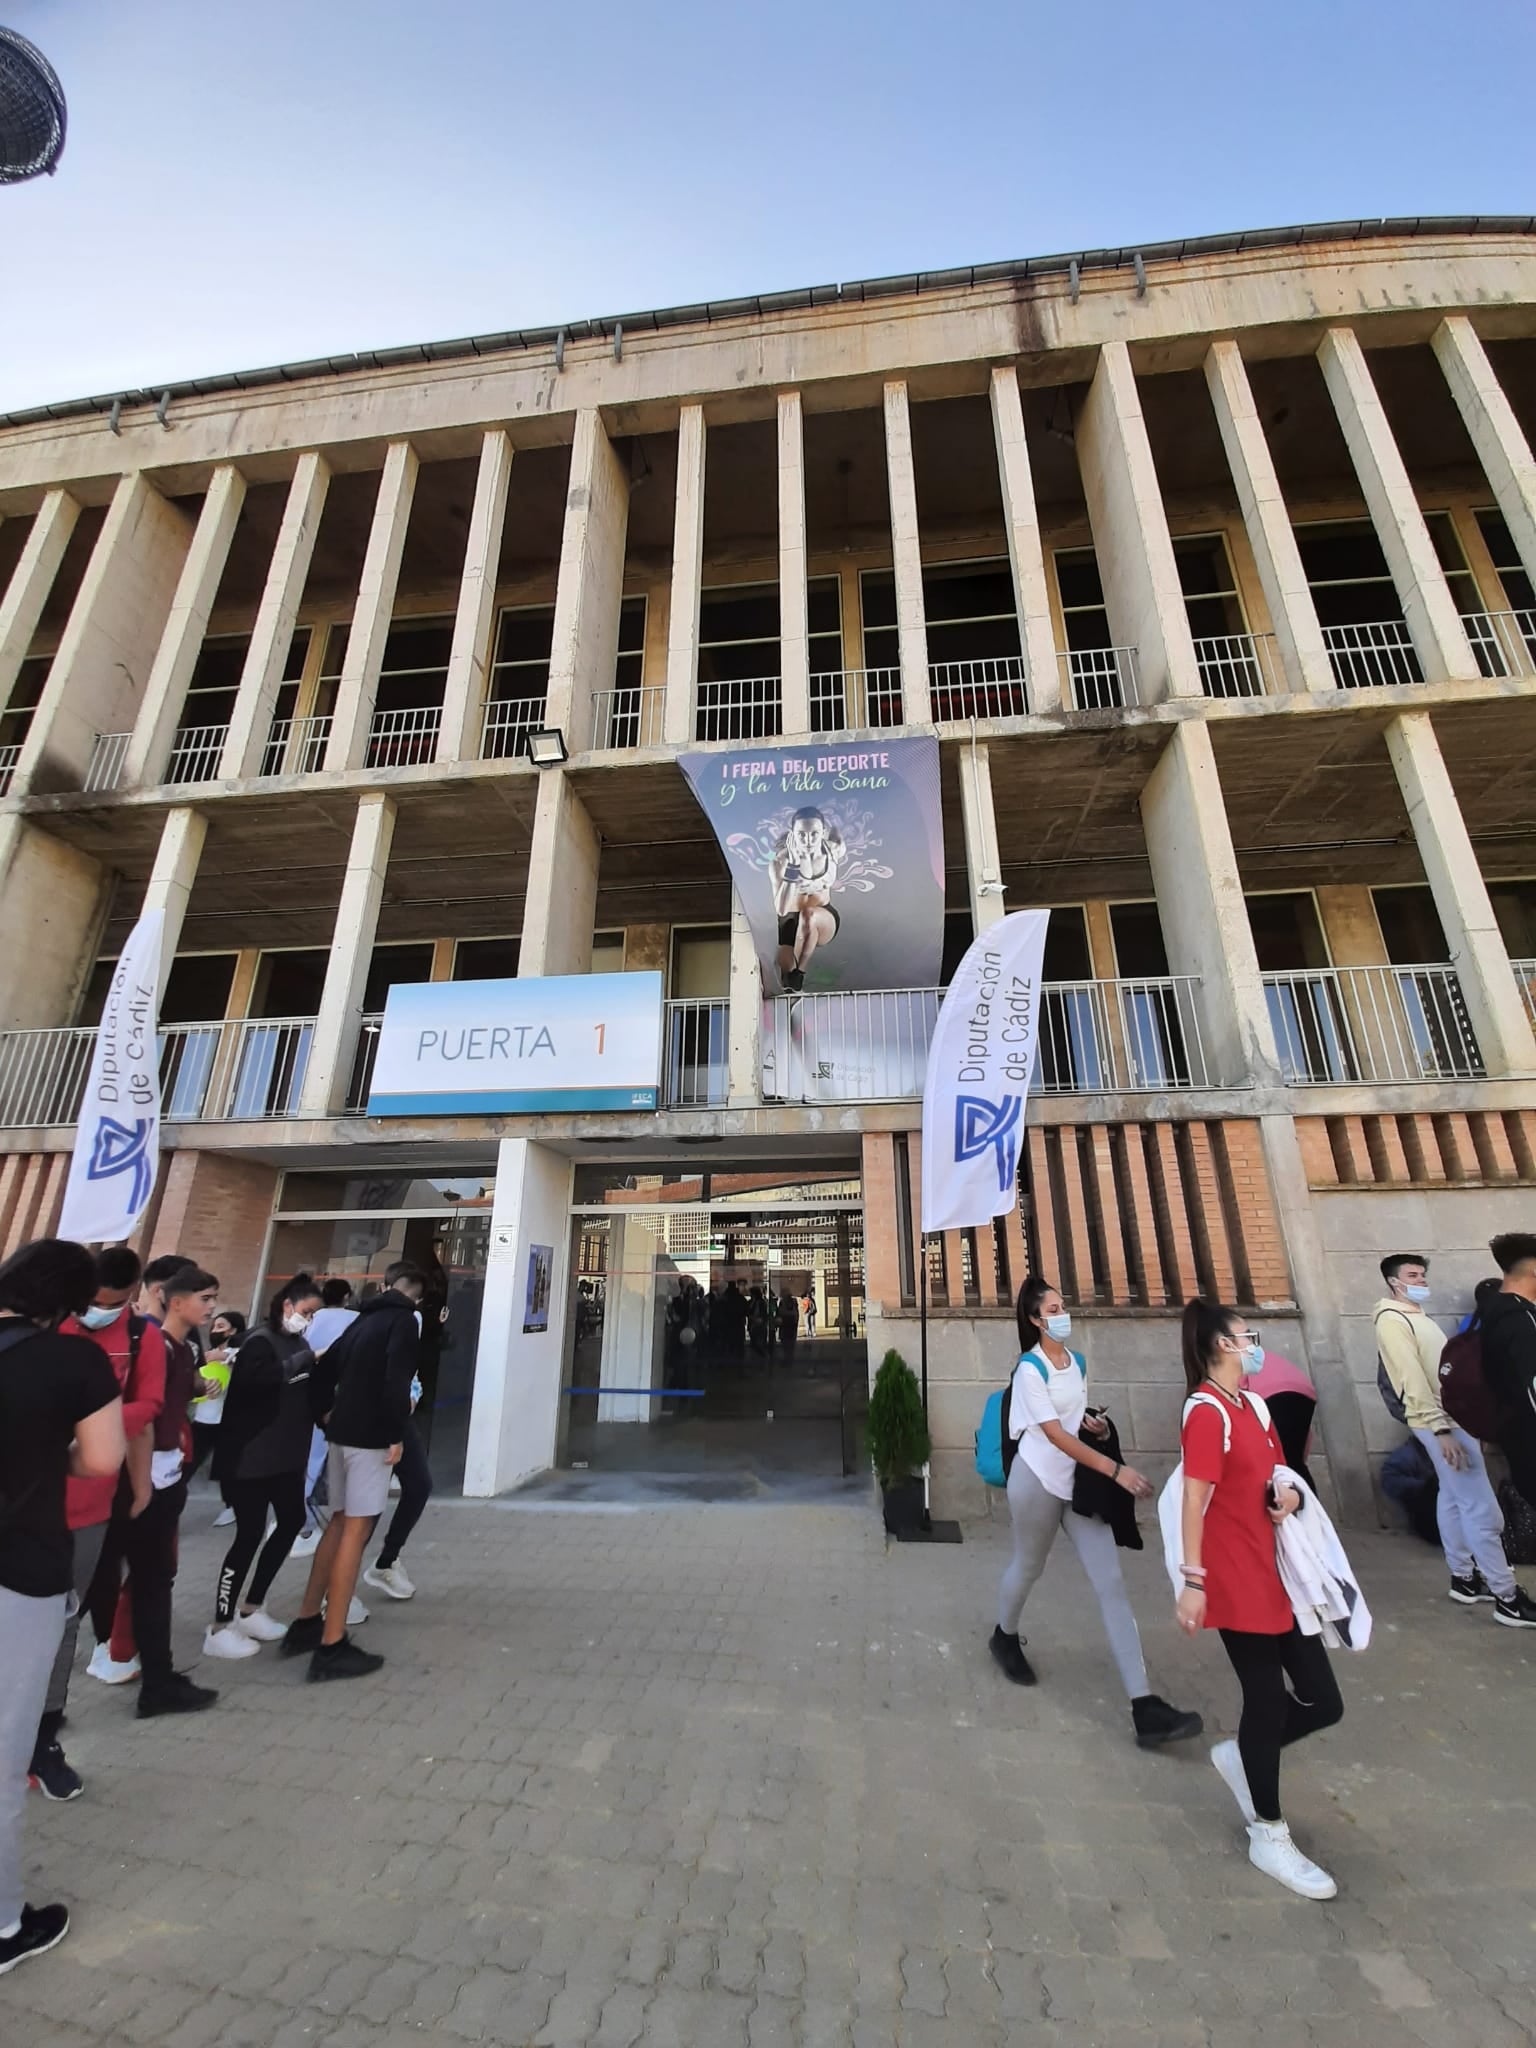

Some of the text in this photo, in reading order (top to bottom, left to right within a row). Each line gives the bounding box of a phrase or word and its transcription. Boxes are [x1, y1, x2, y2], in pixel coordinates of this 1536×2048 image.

[720, 765, 892, 808] y la Vida Sana
[722, 752, 891, 779] I FERIA DEL DEPORTE
[98, 957, 132, 1103] Diputació
[957, 951, 1002, 1082] Diputación
[999, 976, 1031, 1081] de Cádiz
[417, 1023, 606, 1061] PUERTA 1
[128, 1073, 155, 1105] de
